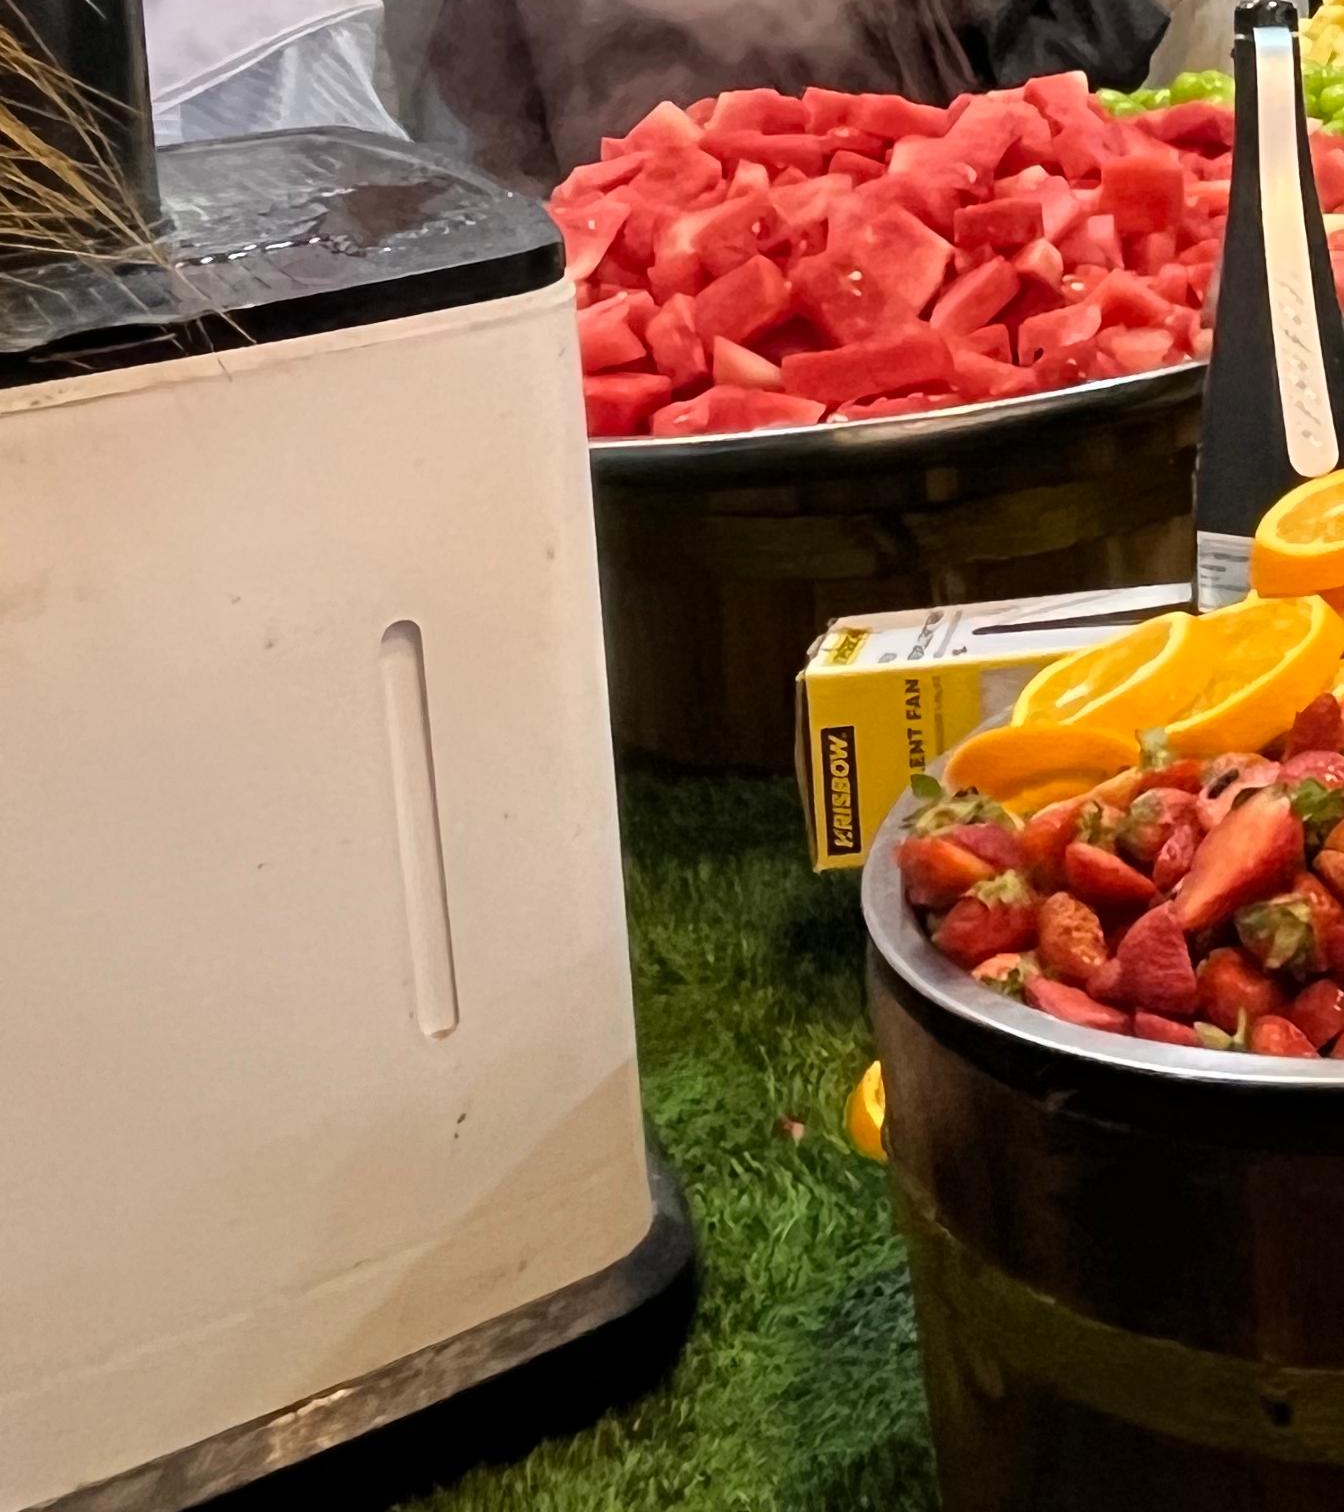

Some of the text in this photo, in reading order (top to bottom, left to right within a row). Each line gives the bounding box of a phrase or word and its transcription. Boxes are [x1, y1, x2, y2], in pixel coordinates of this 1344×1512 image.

[904, 679, 926, 772] ENT FAN
[827, 734, 855, 849] KRISBOW
